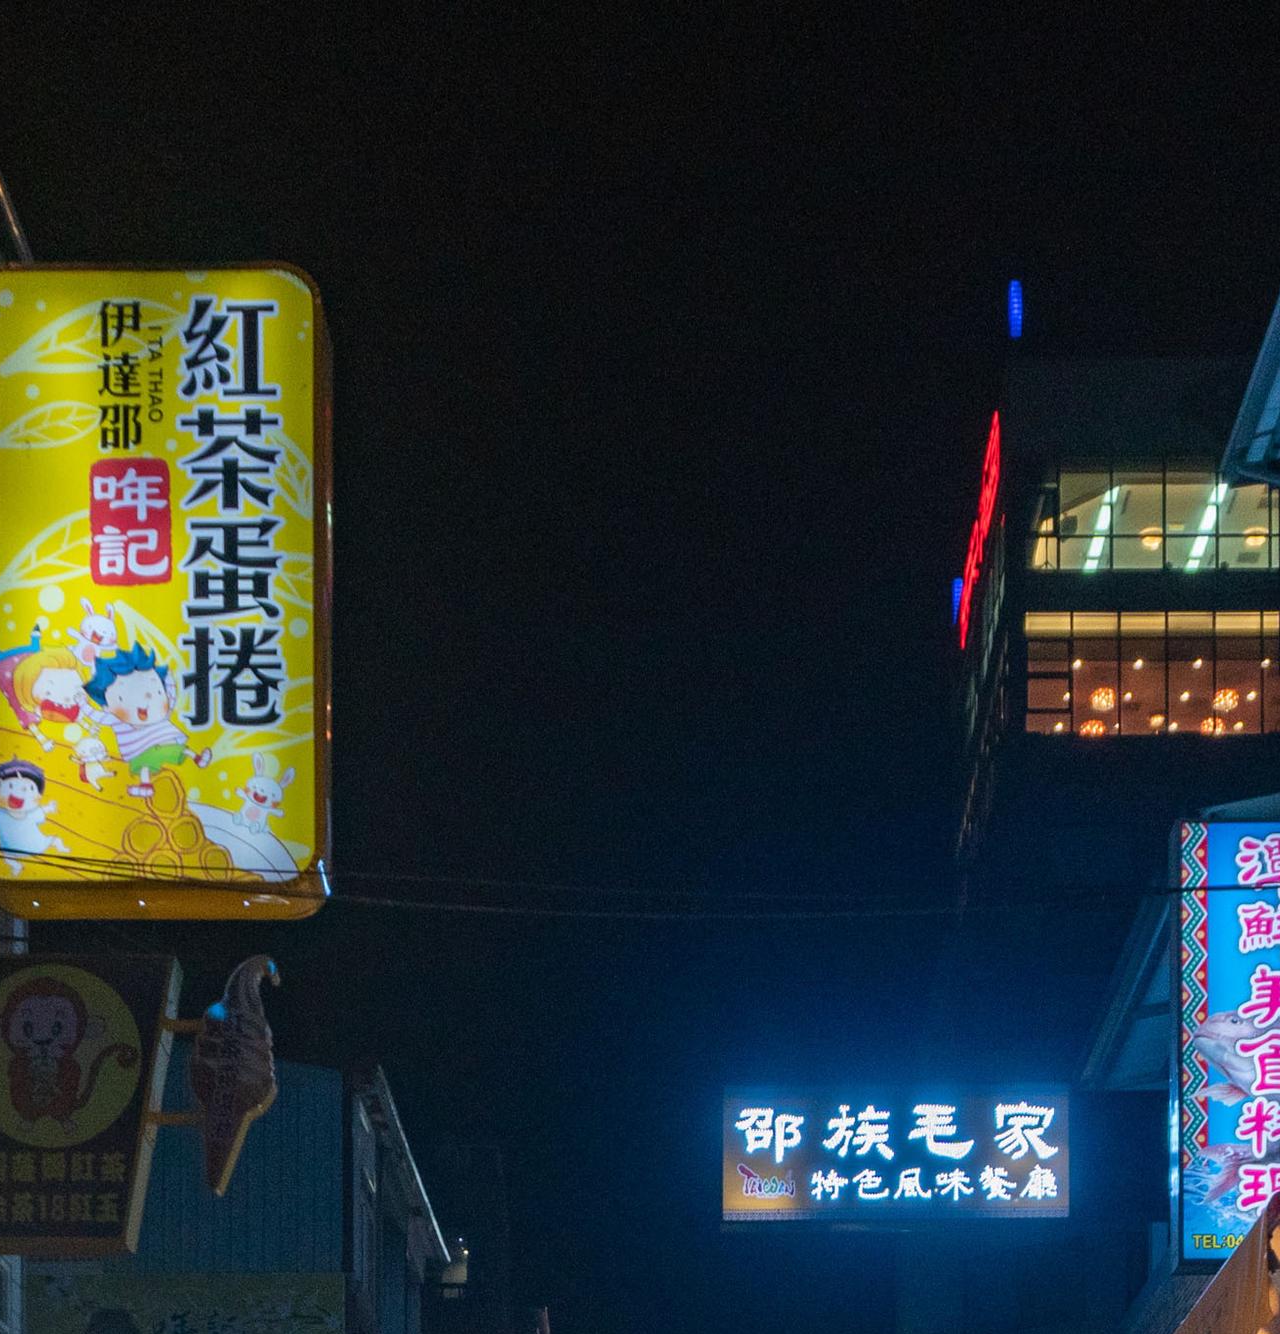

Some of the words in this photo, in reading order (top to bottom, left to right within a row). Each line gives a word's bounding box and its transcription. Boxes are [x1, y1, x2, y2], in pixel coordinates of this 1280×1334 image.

[98, 301, 142, 449] 伊達邵
[148, 368, 163, 423] THAO
[179, 297, 284, 729] 紅茶蛋捲
[736, 1102, 1058, 1163] 邵族毛家
[810, 1165, 1057, 1200] 特色風味餐廳
